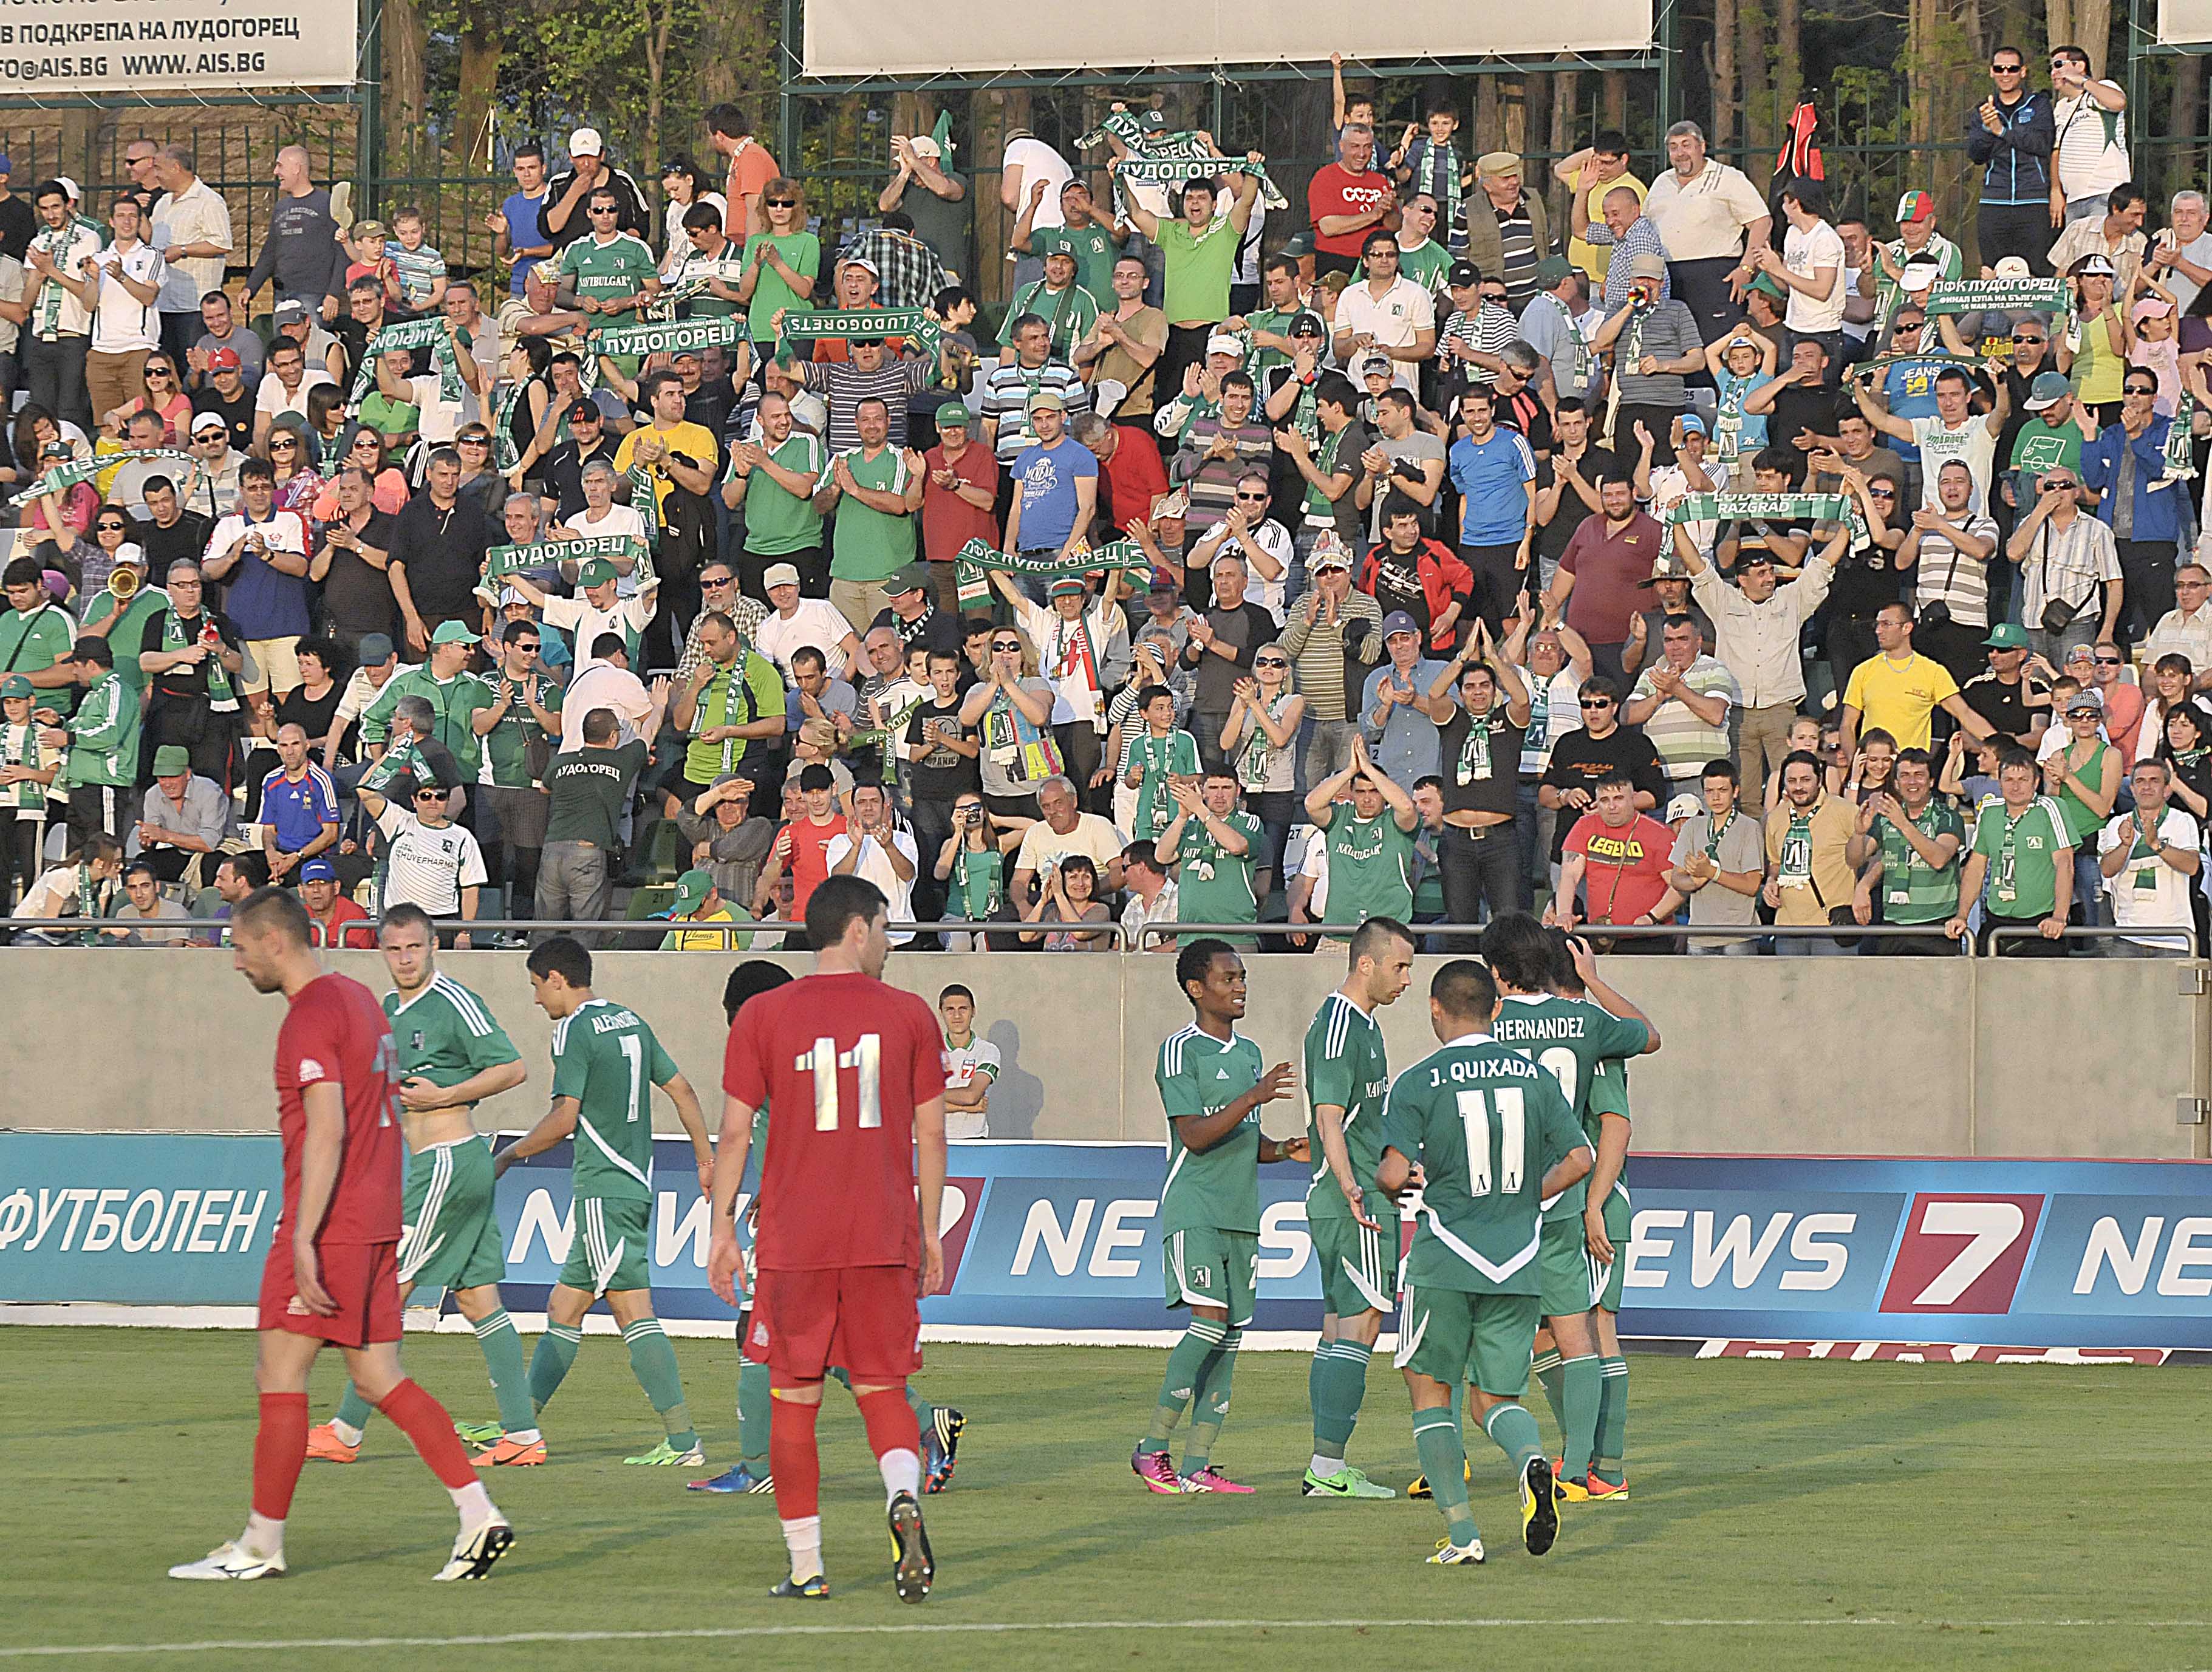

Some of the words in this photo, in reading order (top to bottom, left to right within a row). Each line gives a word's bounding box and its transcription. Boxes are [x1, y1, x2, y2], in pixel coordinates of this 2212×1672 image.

[1, 26, 13, 44] В
[20, 22, 134, 46] ПОДКРЕПА
[139, 21, 166, 40] НА
[171, 18, 299, 41] ЛУДОГОРЕЦ
[1933, 280, 1967, 293] ПФК
[1968, 278, 2060, 293] ЛУДОГОРЕЦ
[791, 315, 909, 332] LUDOGORETS
[605, 325, 734, 355] ЛУДОГОРЕЦ
[1901, 366, 1941, 380] JEANS
[1718, 502, 1790, 514] RAZGRAD
[503, 536, 626, 568] ЛУДОГОРЕЦ
[555, 763, 620, 782] ЛУДОГОРЕЦ
[1289, 828, 1302, 840] 27
[652, 893, 664, 903] 21
[1493, 1017, 1585, 1041] HERNANDEZ
[795, 1033, 882, 1131] 11
[1430, 1068, 1447, 1087] J.
[1450, 1058, 1538, 1083] QUIXADA
[1456, 1087, 1524, 1197] 11
[0, 1188, 268, 1254] ФУТБОЛЕН
[1009, 1199, 1313, 1279] NES
[1623, 1209, 1857, 1291] EWS
[1912, 1202, 2024, 1306] 7
